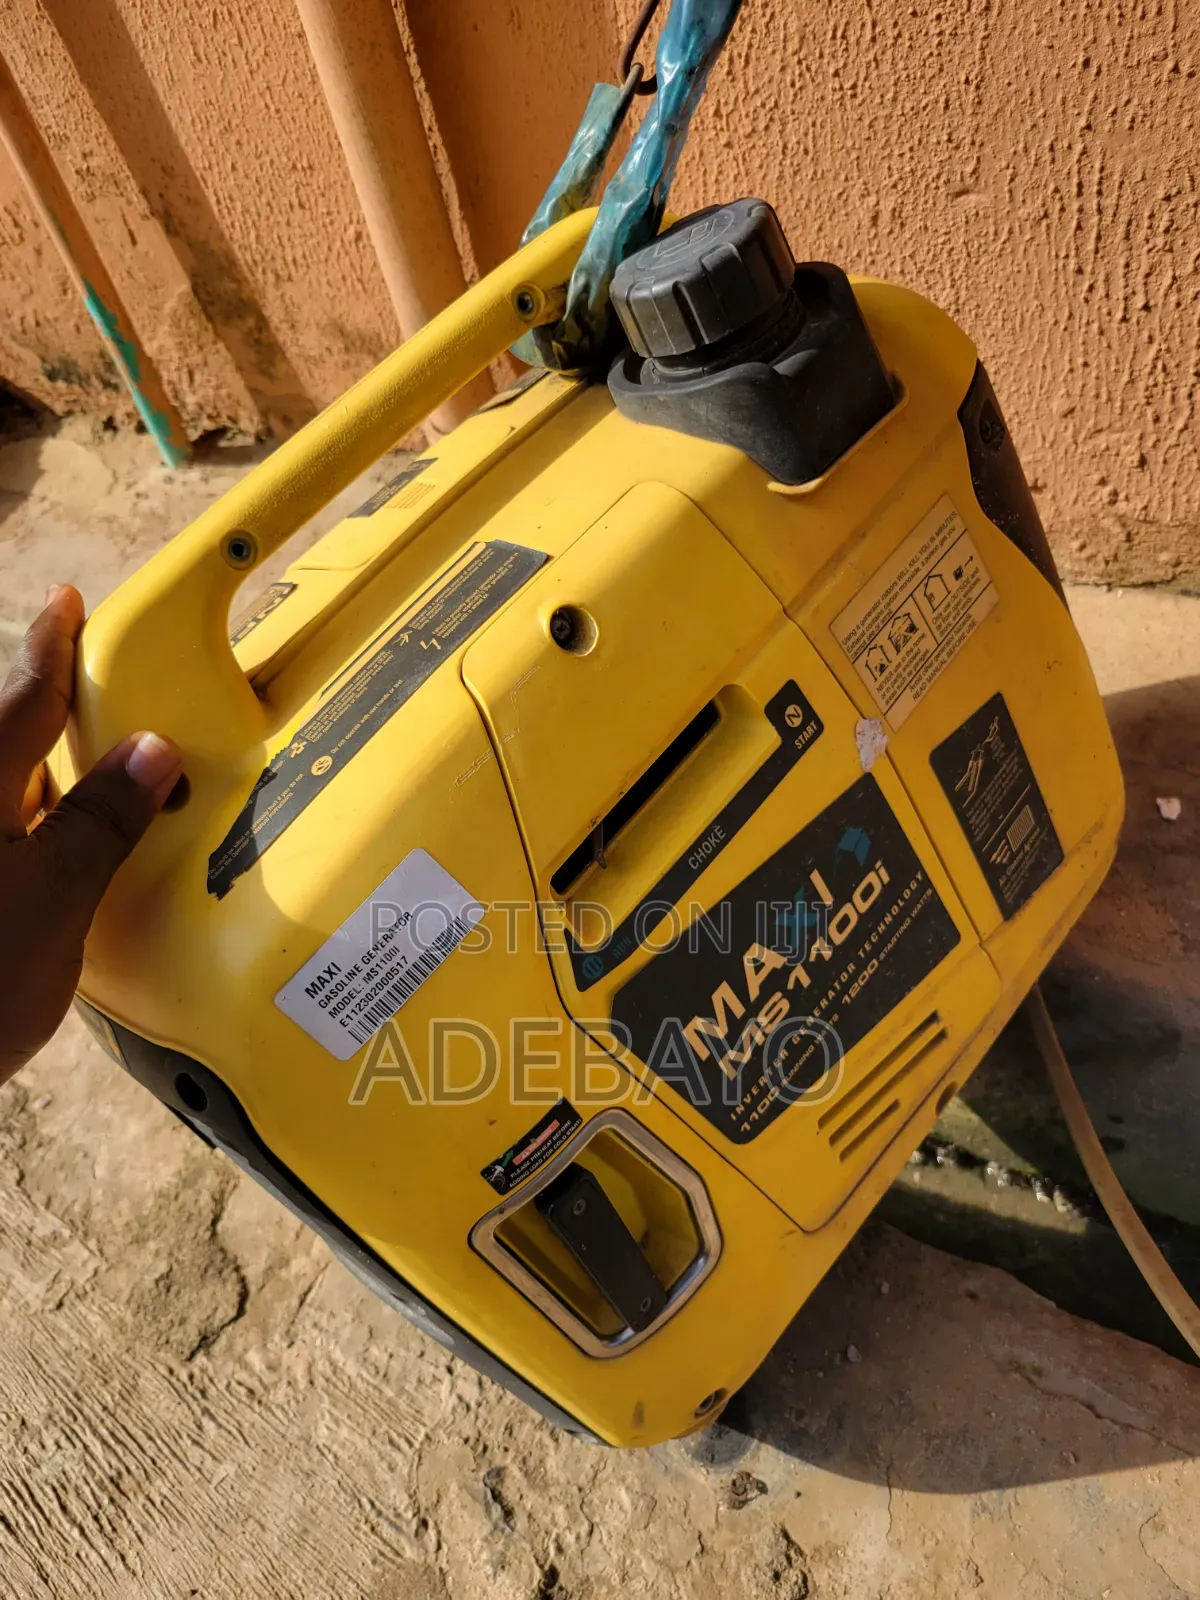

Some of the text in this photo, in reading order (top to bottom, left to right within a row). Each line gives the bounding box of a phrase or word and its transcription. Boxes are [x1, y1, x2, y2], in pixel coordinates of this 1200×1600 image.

[790, 718, 821, 751] START
[685, 824, 729, 871] CHOKE
[303, 960, 342, 1000] MAXI
[317, 909, 414, 1010] GASOLINE GENERATOR
[338, 954, 410, 1029] E112302000517
[712, 857, 900, 1082] MS1100i
[327, 981, 365, 1020] MODEL:
[728, 867, 927, 1125] INVERTER GENERATOR TECHNOLOGY
[738, 885, 935, 1138] 1100 RUNNING WATTS 1200 STARTING WATTS
[509, 1158, 531, 1179] PLEASE
[529, 1138, 553, 1161] PREHEAT
[550, 1119, 572, 1141] BEFORE
